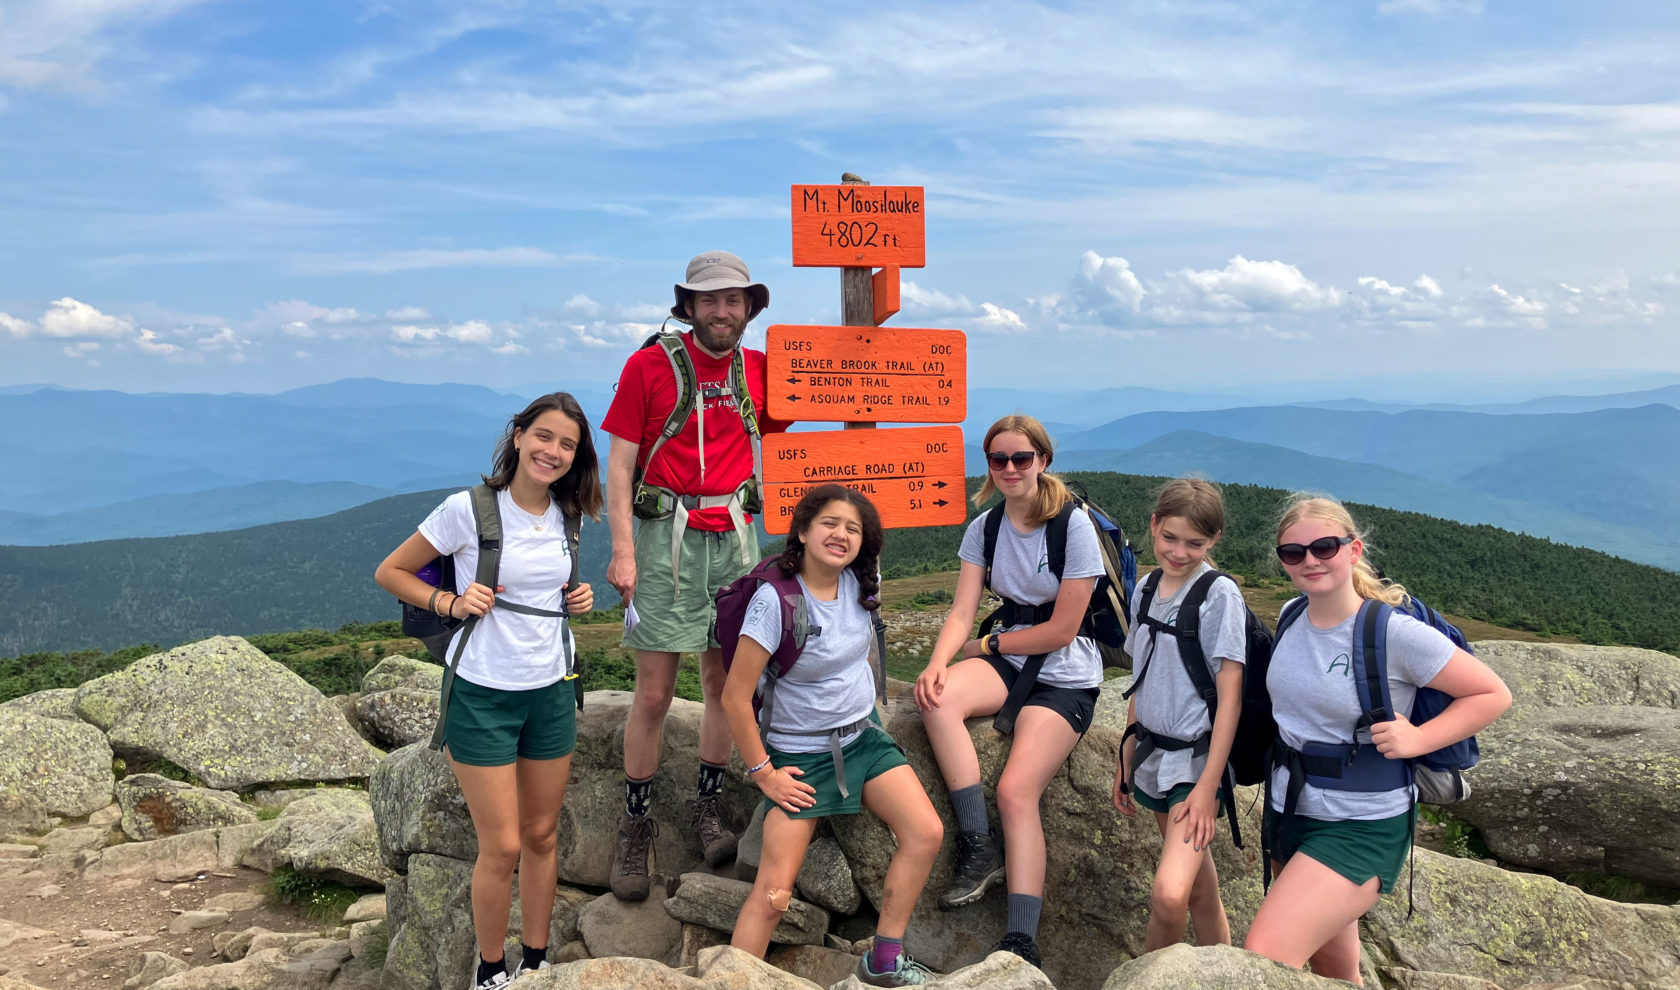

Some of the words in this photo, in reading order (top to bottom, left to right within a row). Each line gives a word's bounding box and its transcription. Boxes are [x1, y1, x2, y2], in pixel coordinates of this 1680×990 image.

[803, 188, 830, 213] Mt.
[837, 188, 920, 214] Moosilauke
[820, 221, 879, 248] 4802
[784, 340, 812, 352] USFS
[931, 344, 952, 355] DOC
[791, 358, 833, 370] BEAVER
[841, 359, 877, 371] BROOK
[886, 361, 915, 372] TRAIL
[922, 361, 945, 374] (AT)
[809, 376, 853, 387] BENTON
[860, 377, 890, 388] TRAIL
[938, 379, 952, 390] 0.4
[809, 394, 855, 406] ASQUAM
[862, 395, 893, 406] RIDGE
[901, 397, 931, 407] TRAIL
[938, 396, 950, 407] 1.9
[926, 442, 949, 454] DOC
[778, 449, 807, 461] USFS
[803, 464, 858, 478] CARRIAGE
[865, 463, 895, 475] ROAD
[902, 461, 925, 475] (AT)
[908, 480, 924, 492] 0.9
[910, 500, 922, 511] 5.1
